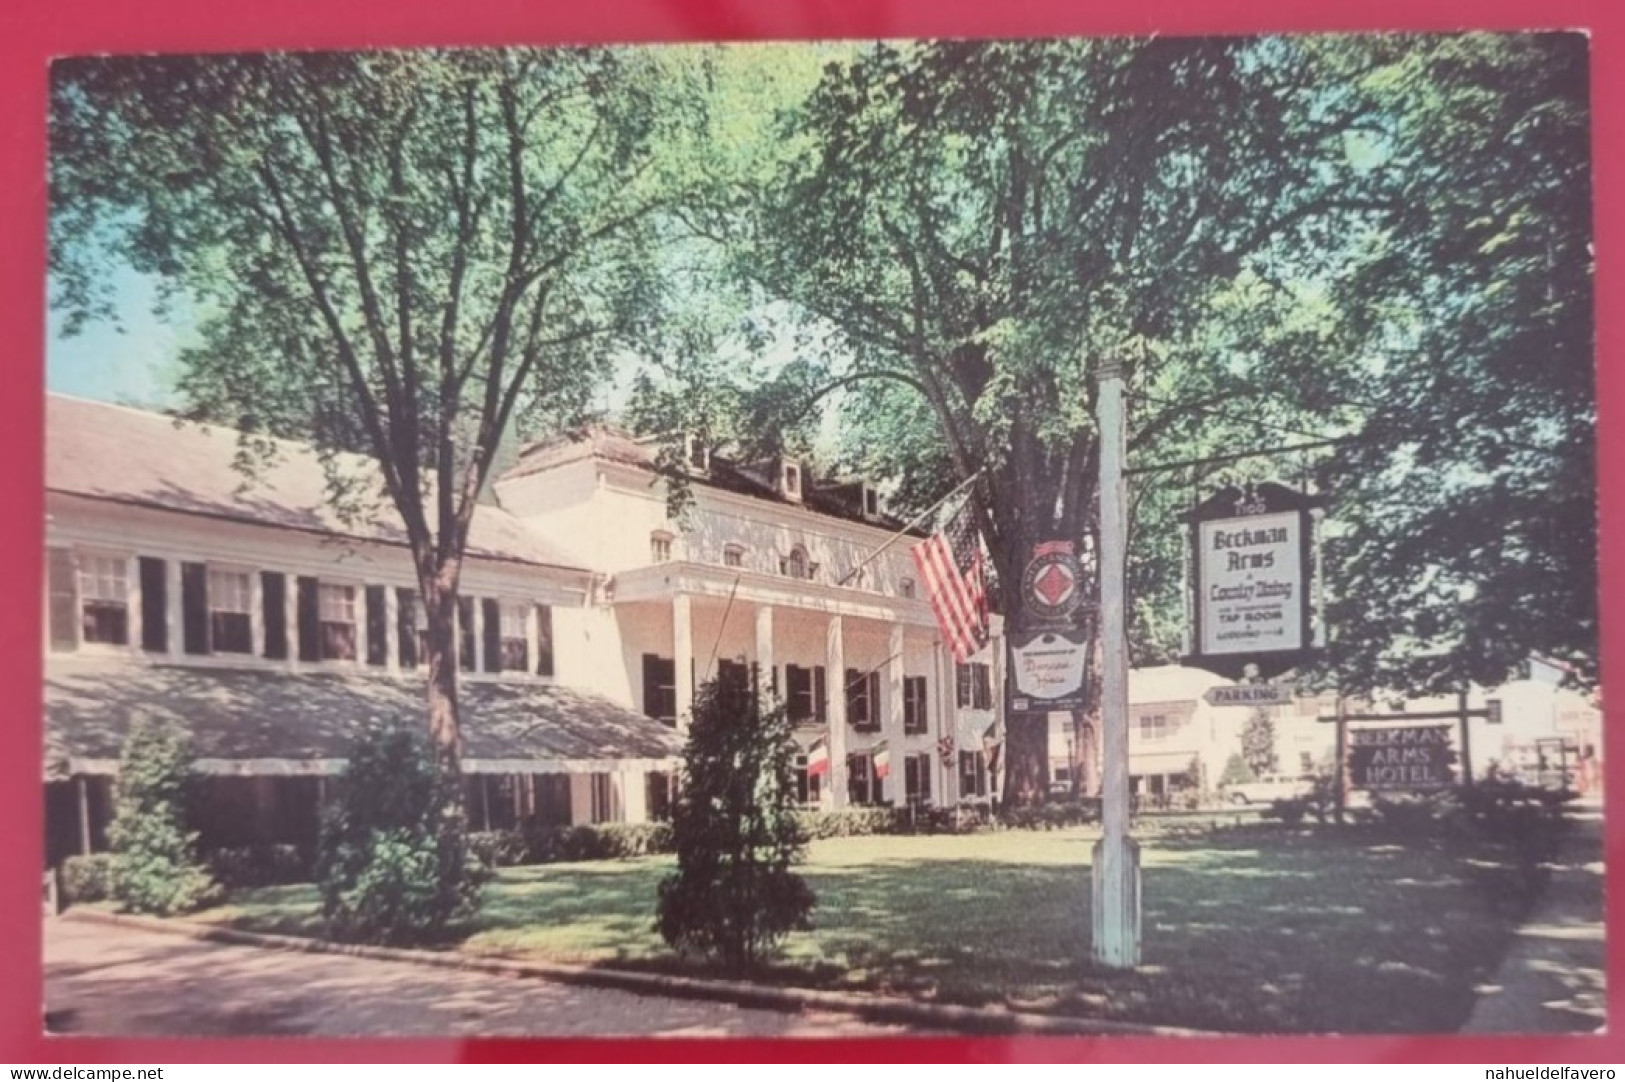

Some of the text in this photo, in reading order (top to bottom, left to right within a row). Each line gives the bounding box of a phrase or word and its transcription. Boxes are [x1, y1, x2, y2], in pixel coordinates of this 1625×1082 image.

[1213, 527, 1288, 550] Beekman
[1226, 550, 1275, 572] Arms
[1214, 688, 1278, 703] PARKING
[1371, 748, 1430, 765] ARMS
[1366, 766, 1437, 783] HOTEL
